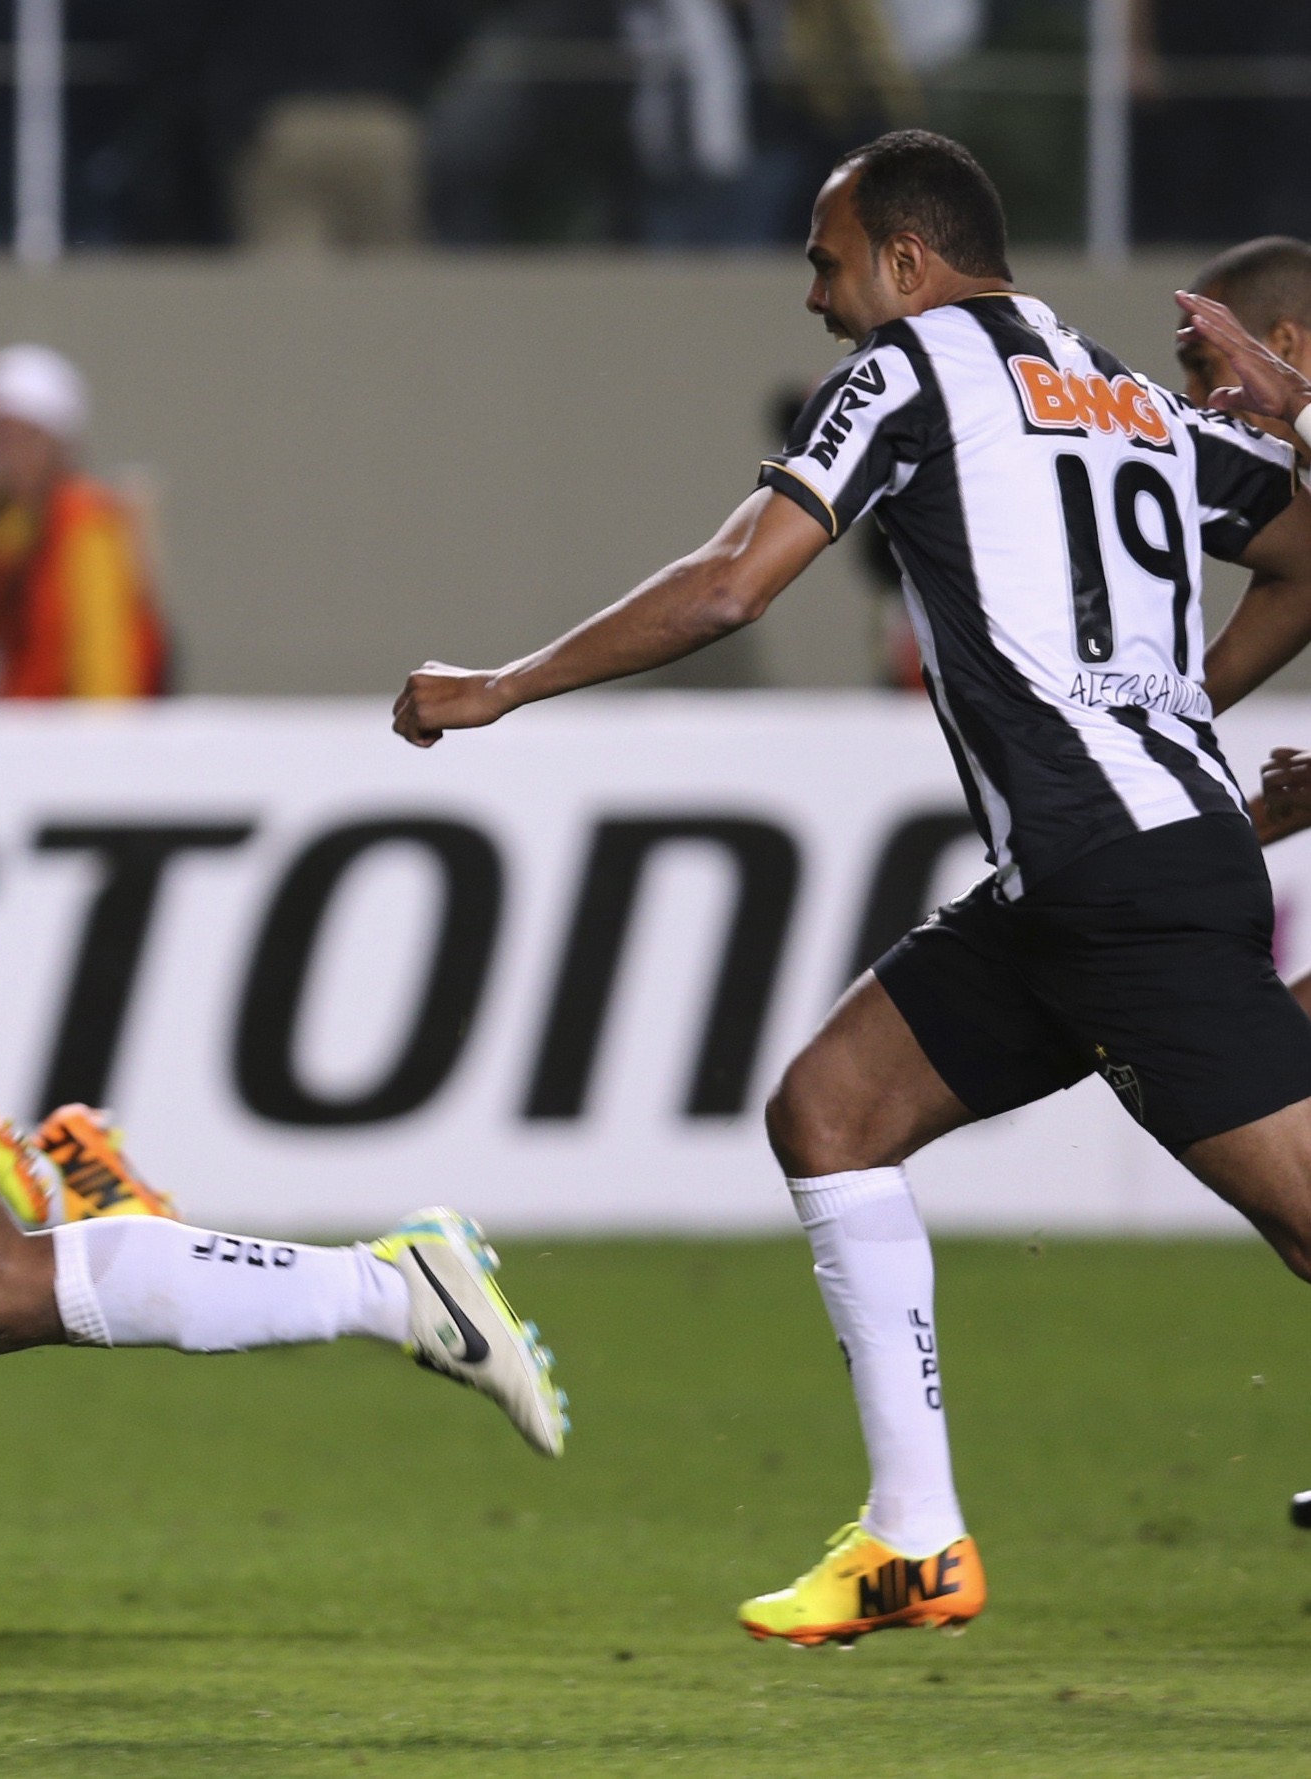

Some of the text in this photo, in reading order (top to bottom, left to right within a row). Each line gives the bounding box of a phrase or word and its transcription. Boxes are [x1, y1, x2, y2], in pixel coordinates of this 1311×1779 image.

[808, 358, 886, 470] MRV
[1010, 356, 1170, 444] BMG
[1055, 451, 1189, 677] 19
[908, 1308, 942, 1410] LUPO
[858, 1540, 961, 1619] NIKE
